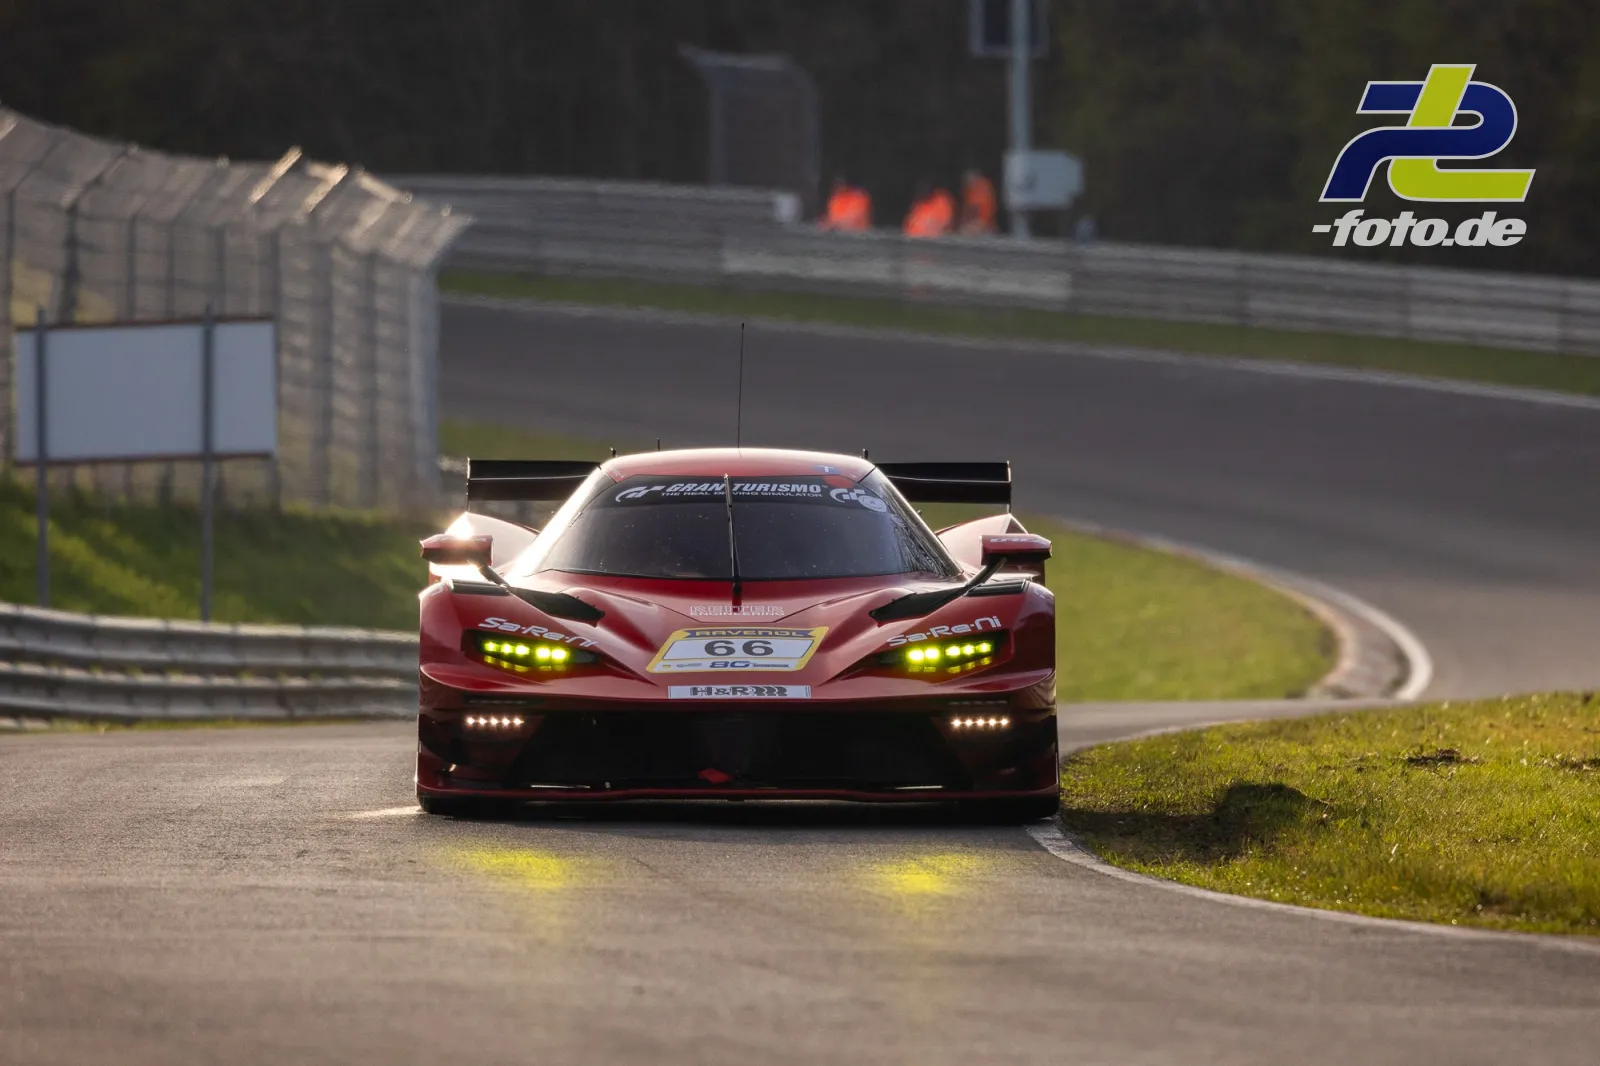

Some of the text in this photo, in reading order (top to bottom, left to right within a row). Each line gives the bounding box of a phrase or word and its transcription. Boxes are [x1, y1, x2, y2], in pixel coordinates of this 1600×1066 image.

[665, 483, 822, 493] GRAN TURISMO
[690, 605, 784, 613] REITER
[695, 629, 804, 637] RAVENOL
[704, 640, 774, 657] 66
[690, 686, 751, 697] H&R
